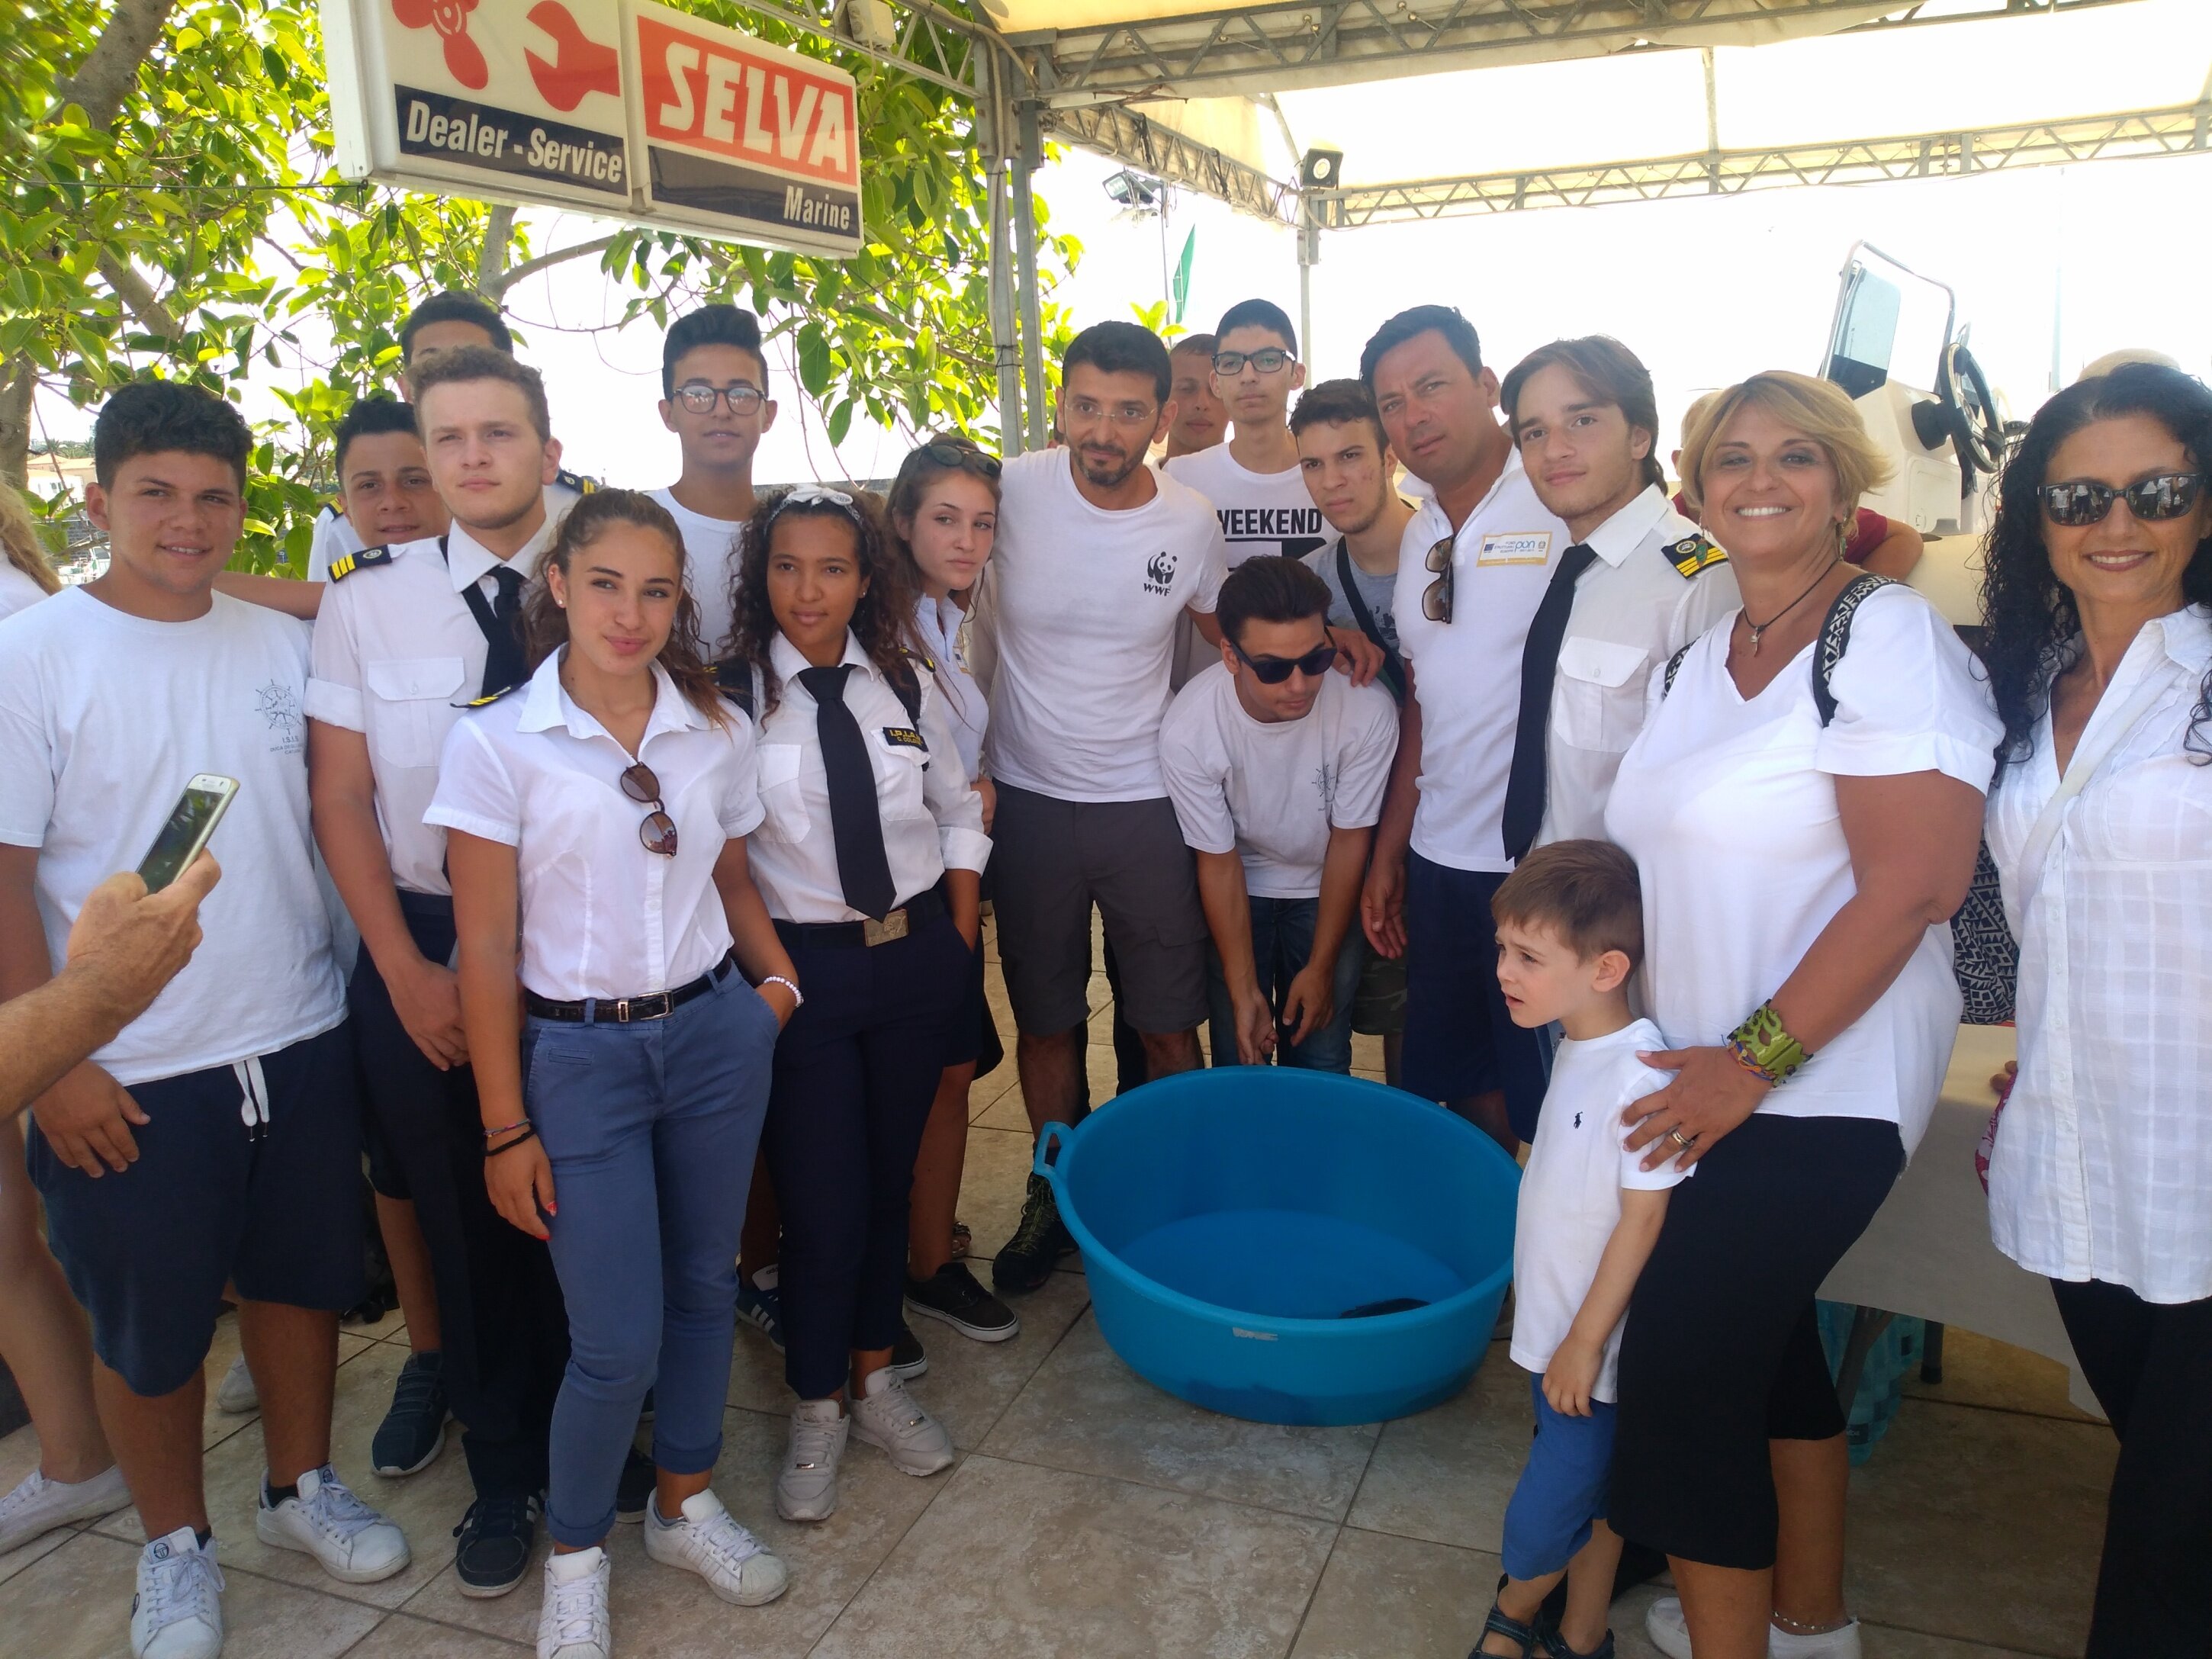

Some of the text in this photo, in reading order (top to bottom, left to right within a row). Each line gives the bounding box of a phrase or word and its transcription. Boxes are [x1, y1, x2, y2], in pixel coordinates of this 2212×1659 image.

[659, 40, 848, 173] SELVA
[406, 99, 509, 159] Dealer
[529, 127, 623, 184] Service
[783, 185, 850, 230] Marine
[1143, 583, 1172, 596] WWF
